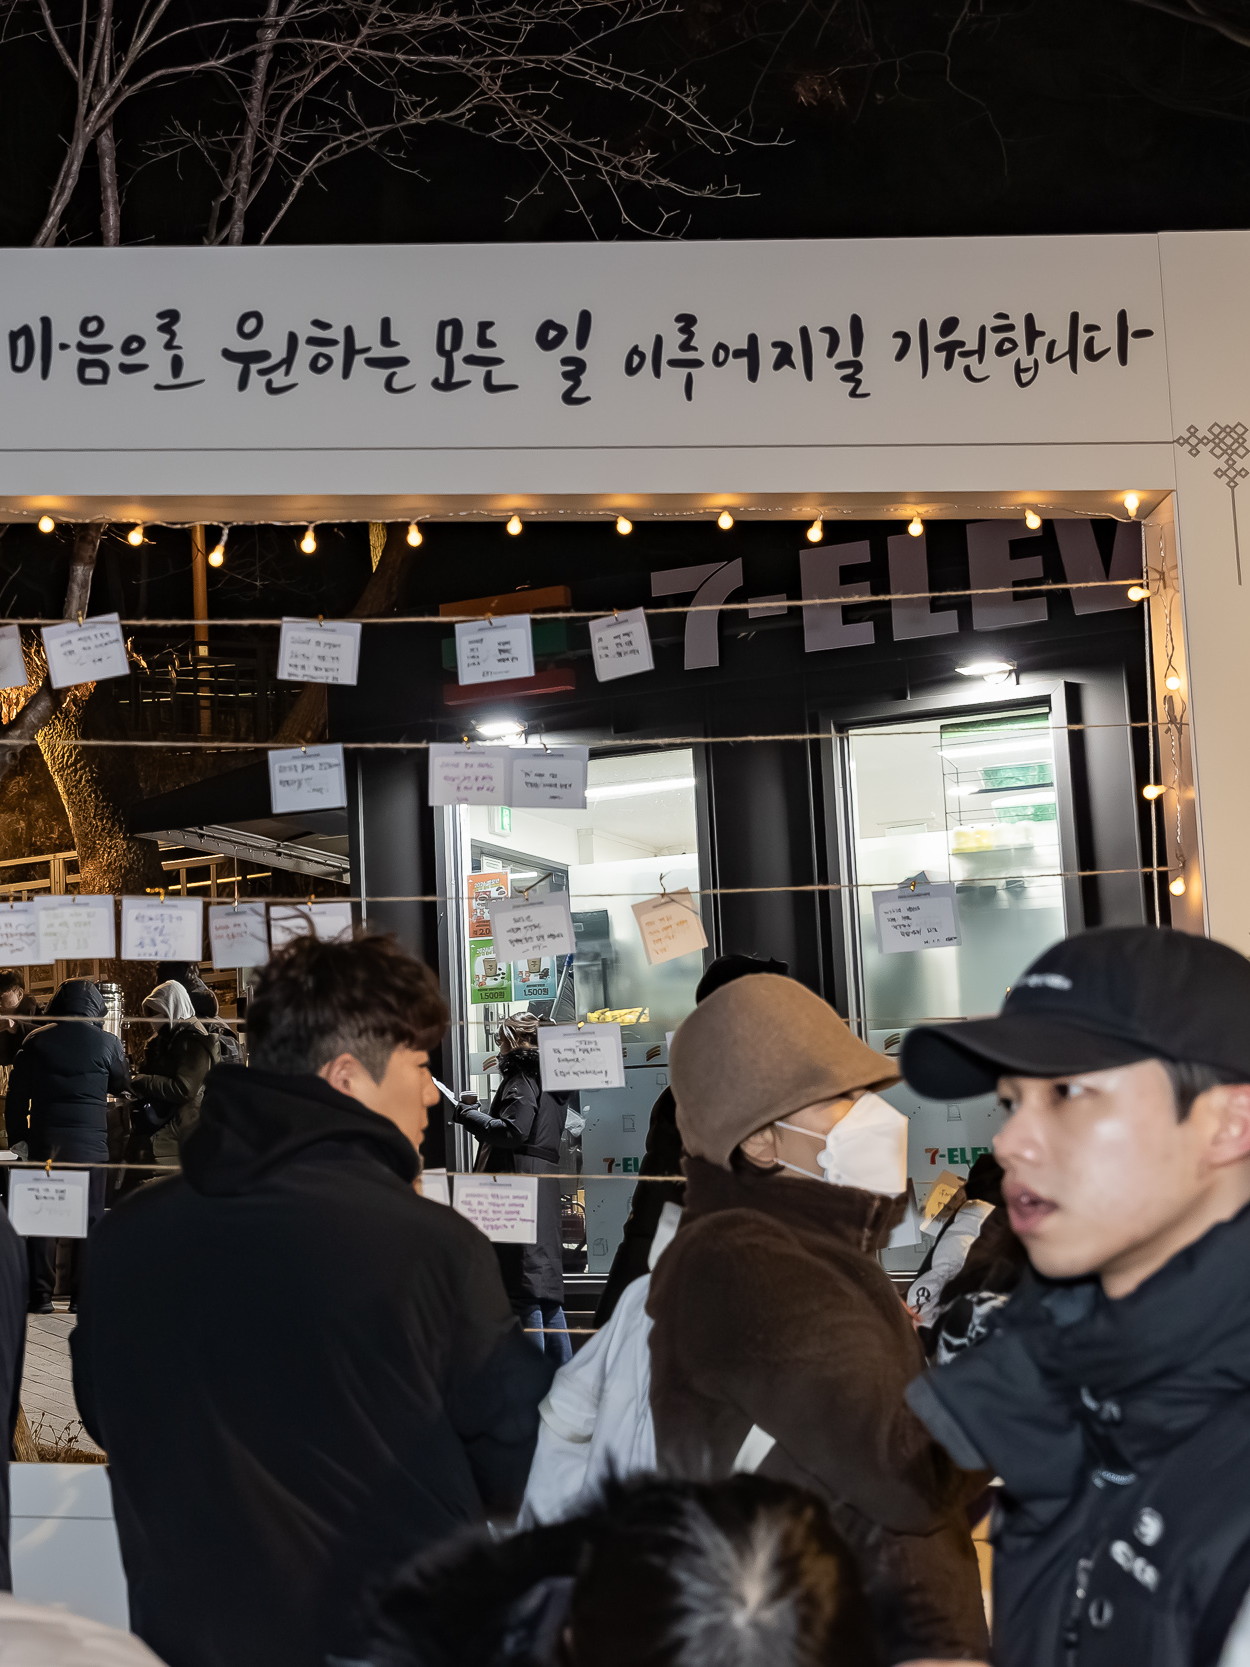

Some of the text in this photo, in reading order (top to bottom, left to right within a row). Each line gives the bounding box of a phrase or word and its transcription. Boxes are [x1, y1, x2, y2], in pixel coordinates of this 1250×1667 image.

[8, 309, 206, 390] 마음으로
[221, 311, 417, 395] 원하는
[431, 317, 519, 393] 모든
[535, 309, 592, 405] 일
[624, 313, 871, 402] 이루어지길
[892, 309, 1155, 389] 기원합니다
